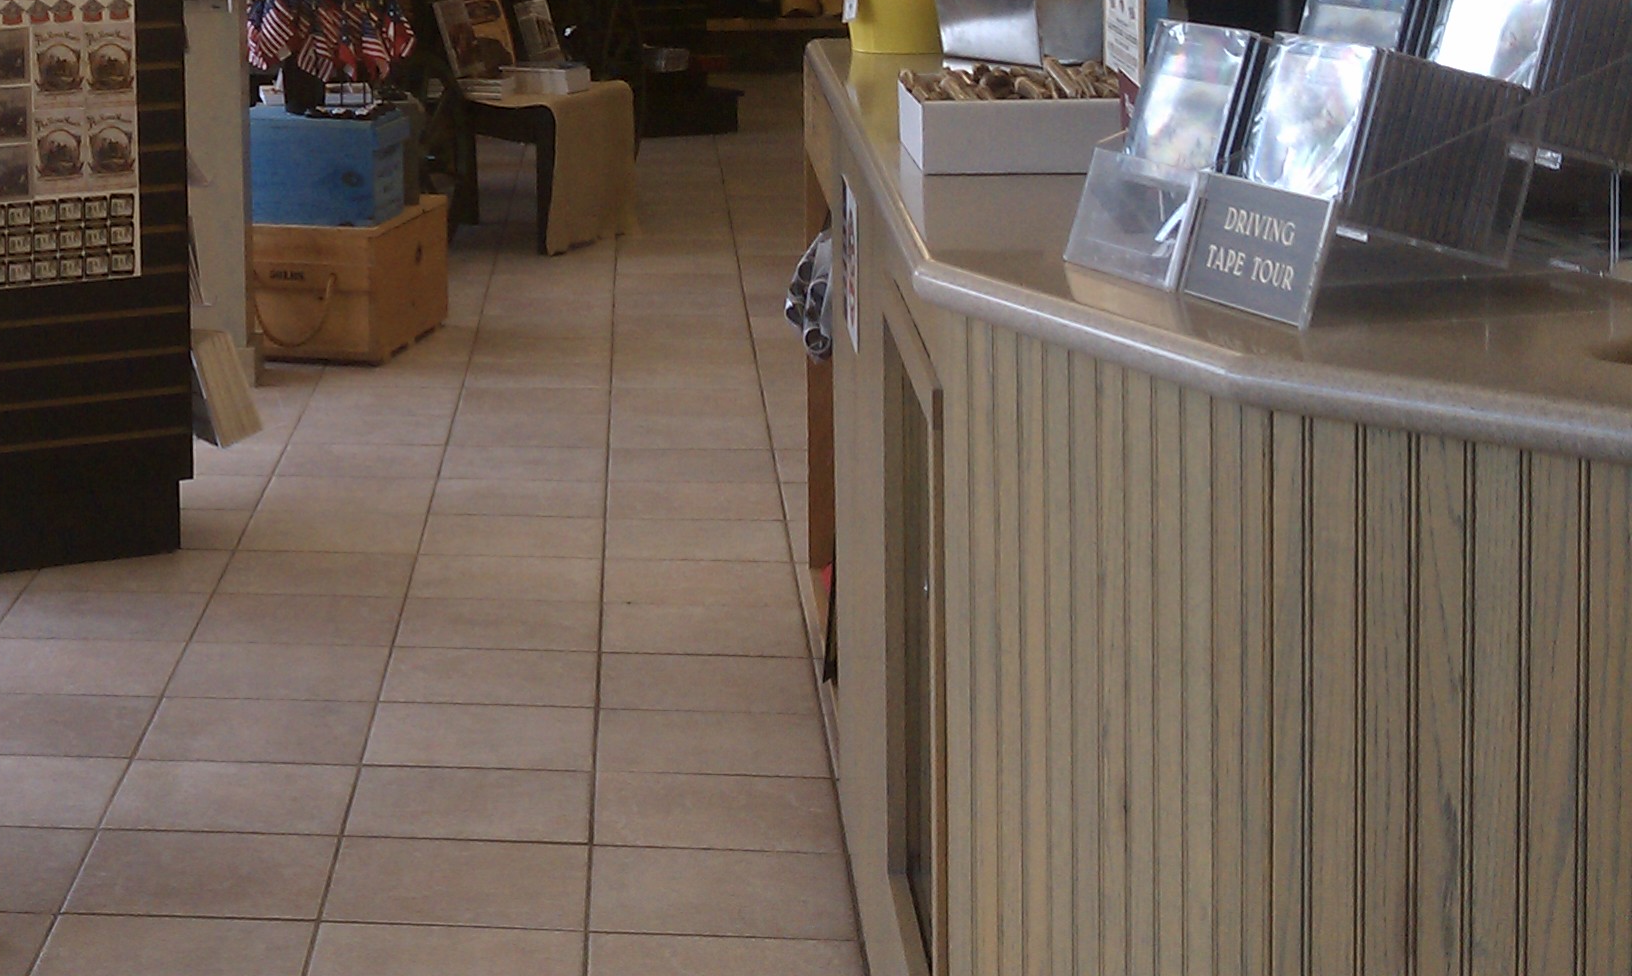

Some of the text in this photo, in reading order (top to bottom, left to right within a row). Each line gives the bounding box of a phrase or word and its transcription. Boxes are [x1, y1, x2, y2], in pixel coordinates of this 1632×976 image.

[1224, 206, 1296, 246] DRIVING
[1206, 244, 1294, 291] TAPE TOUR
